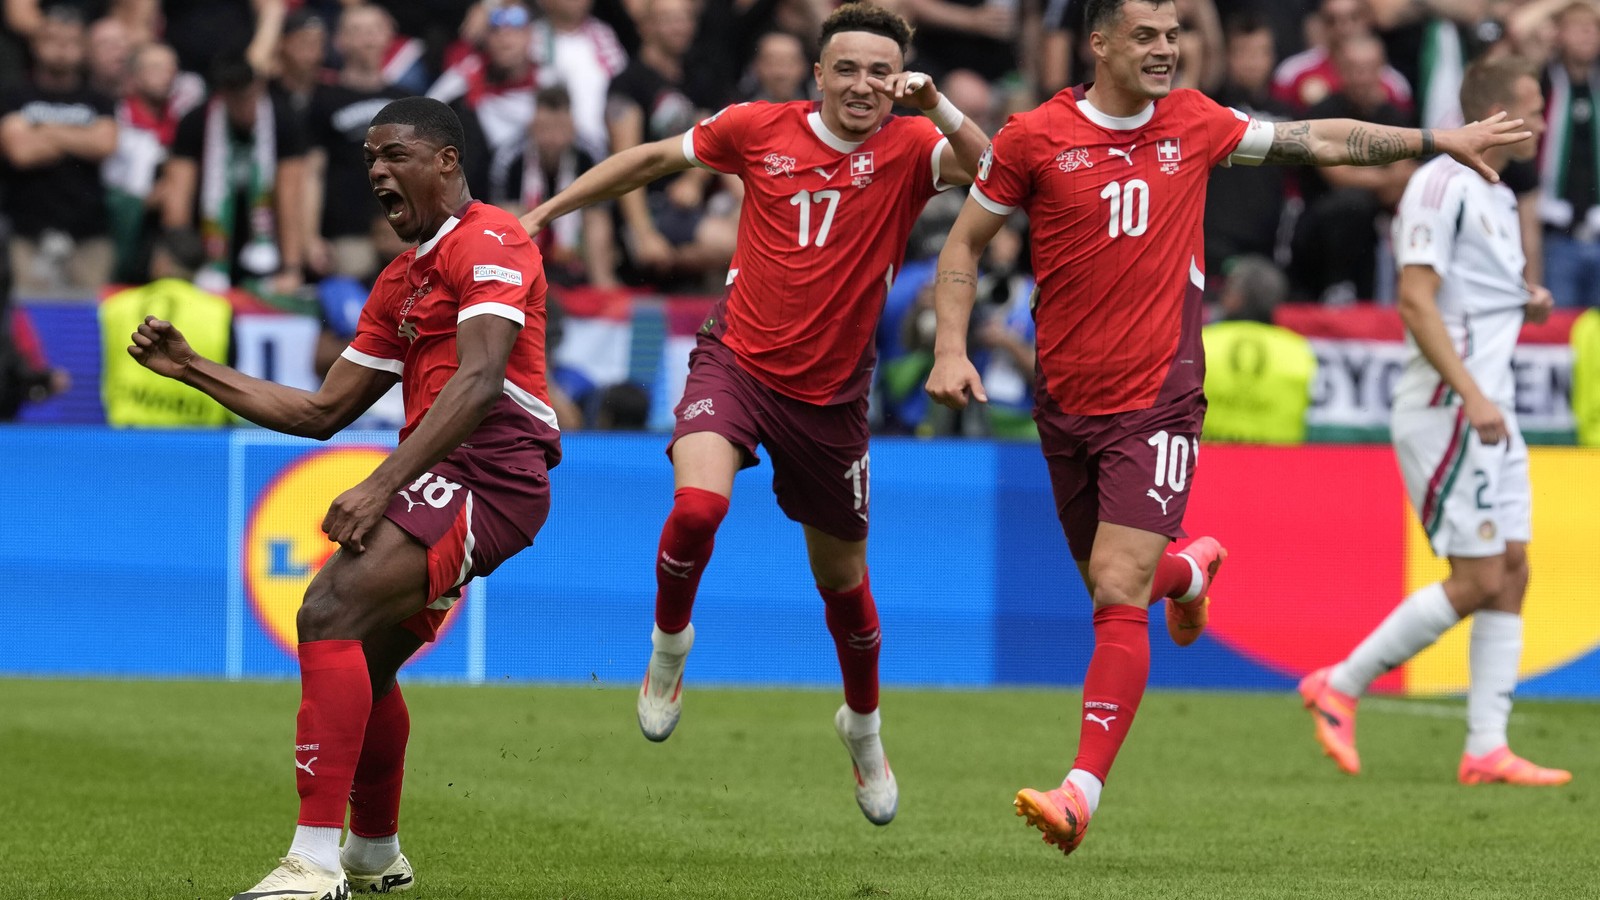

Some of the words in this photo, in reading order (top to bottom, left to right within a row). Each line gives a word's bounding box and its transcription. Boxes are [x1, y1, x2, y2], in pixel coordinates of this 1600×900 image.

[789, 189, 841, 248] 17
[1100, 179, 1149, 238] 10
[1147, 430, 1190, 493] 10
[408, 472, 463, 509] 18
[1474, 467, 1493, 510] 2
[1084, 701, 1119, 711] SUISSE
